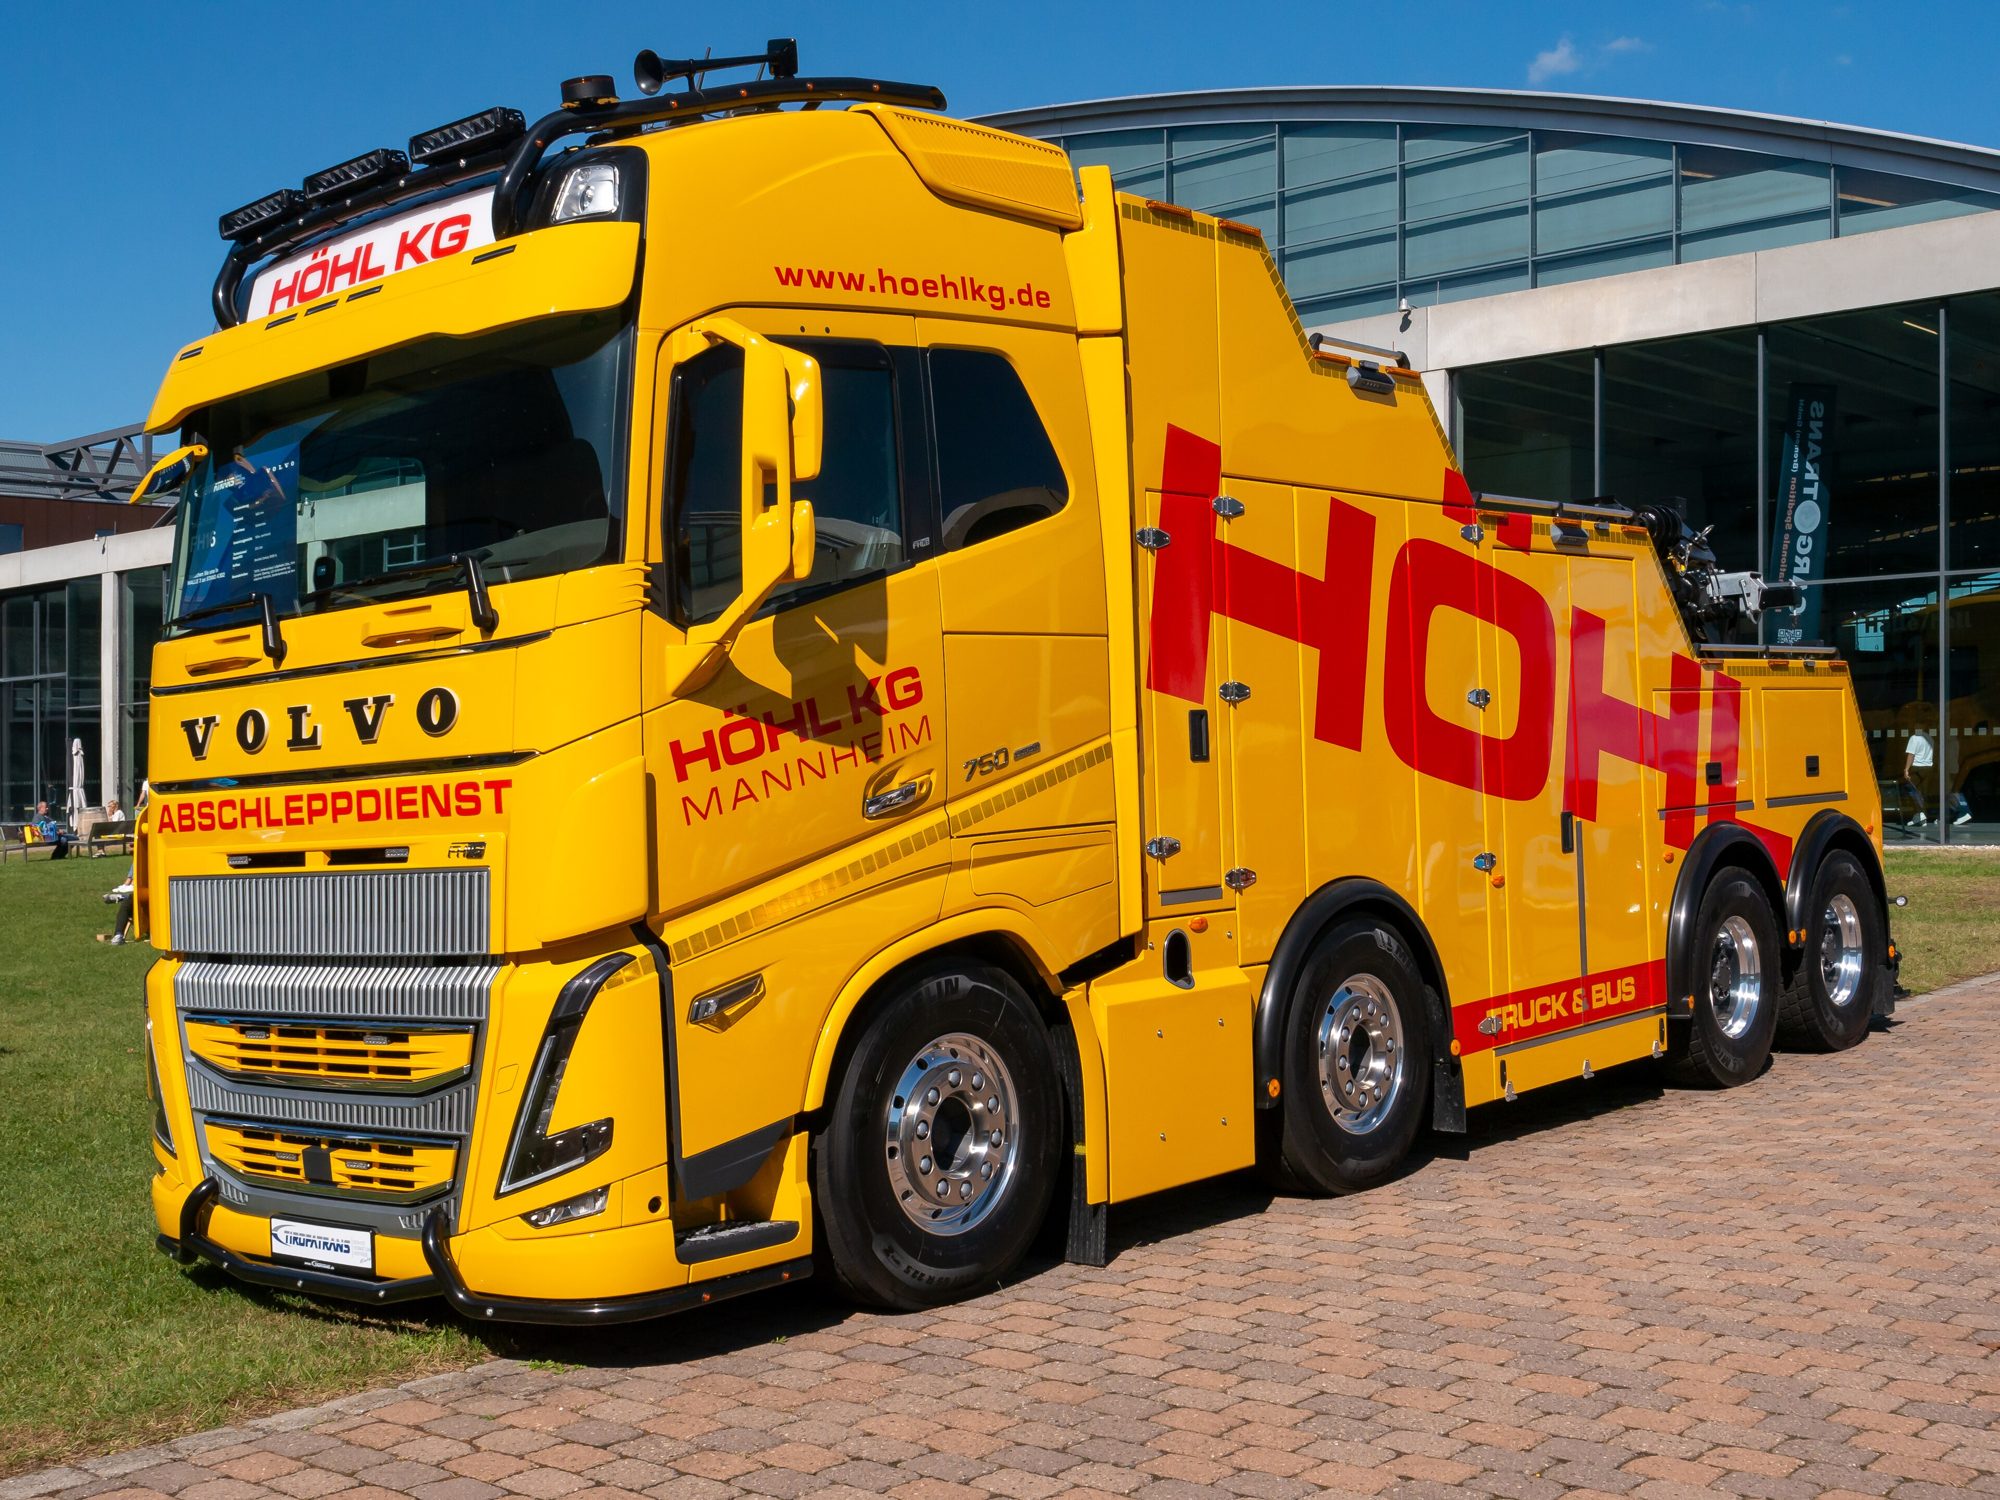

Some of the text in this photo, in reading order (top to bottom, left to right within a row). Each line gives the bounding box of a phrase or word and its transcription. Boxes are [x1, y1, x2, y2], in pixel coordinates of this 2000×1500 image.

[268, 214, 472, 315] HÖHL KG
[774, 265, 1051, 311] www.hoehlkg.de
[1147, 422, 1793, 882] HÖHL
[180, 686, 460, 761] VOLVO
[668, 666, 924, 783] HÖHL KG
[681, 714, 932, 826] MANNHEIM
[962, 746, 1010, 783] 750
[157, 779, 513, 834] ABSCHLEPPDIENST
[1572, 987, 1589, 1014] &
[1592, 976, 1636, 1010] BUS
